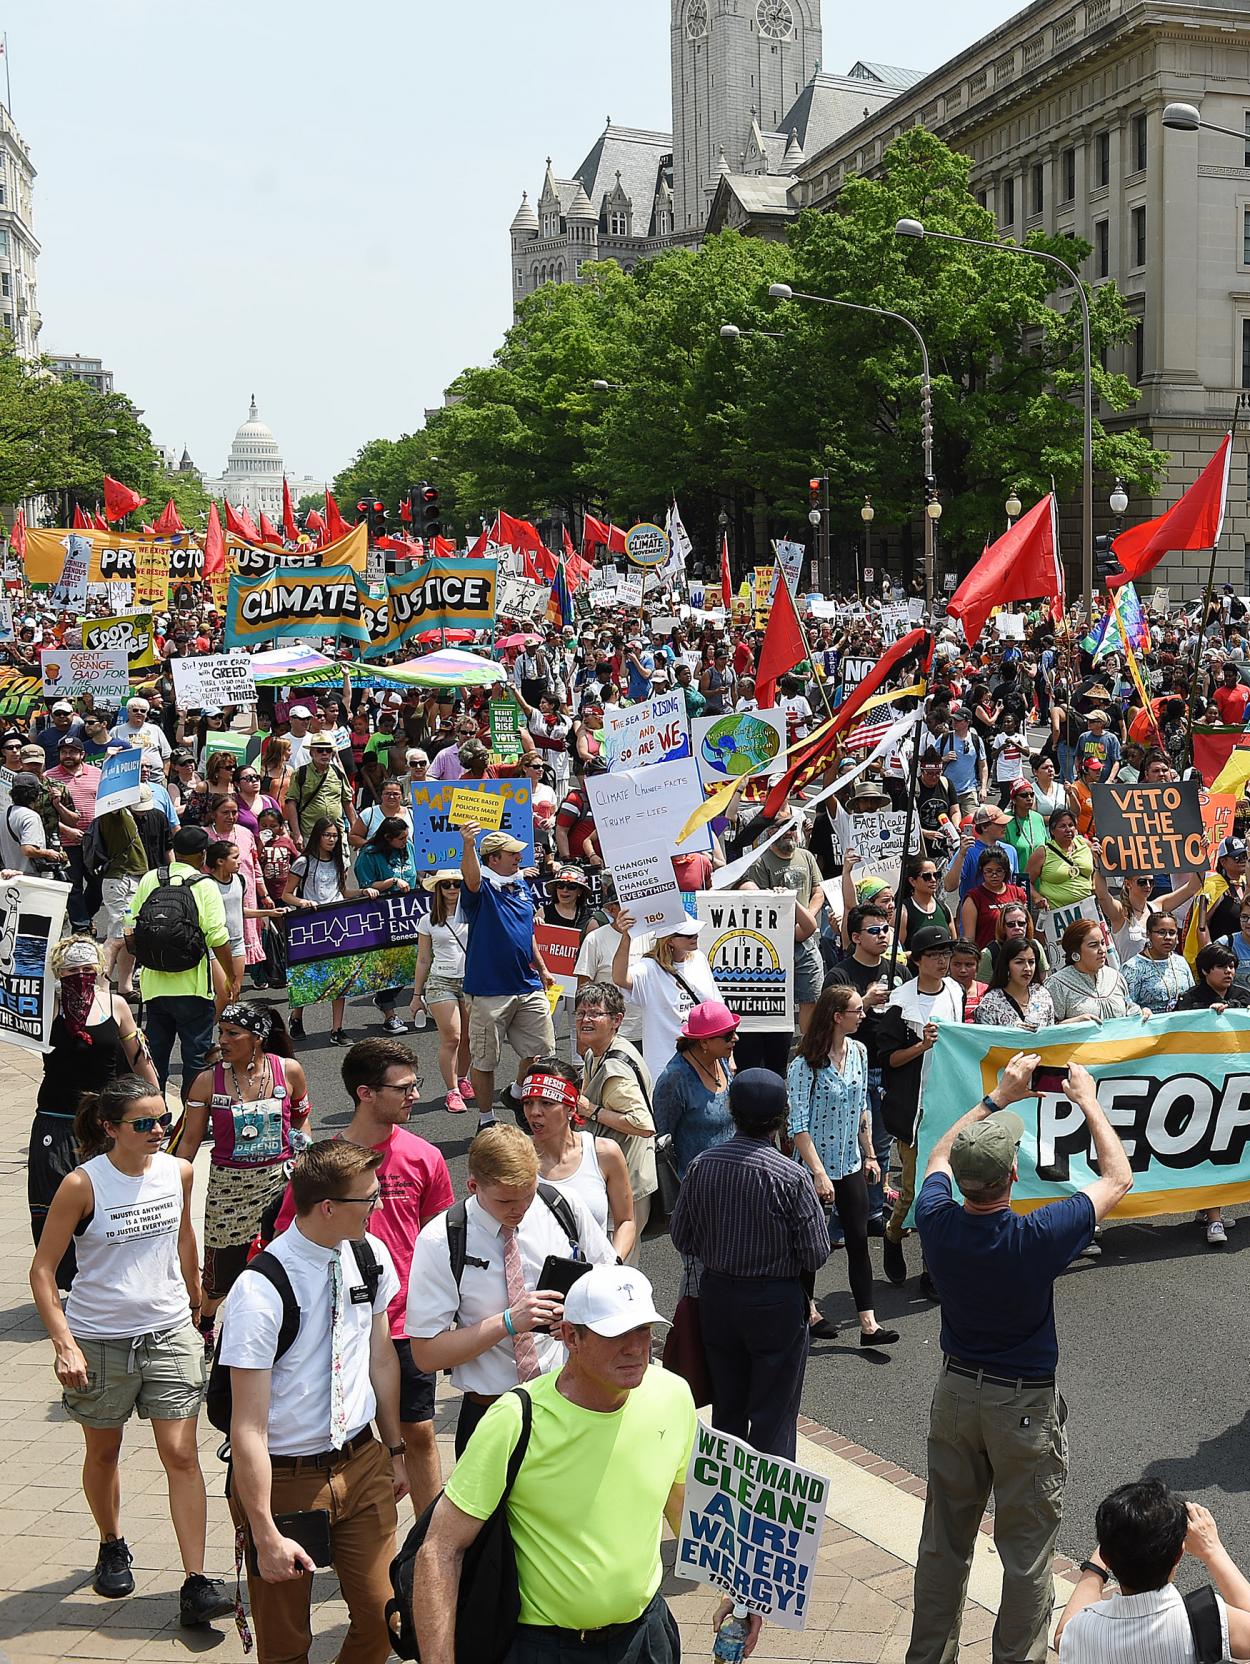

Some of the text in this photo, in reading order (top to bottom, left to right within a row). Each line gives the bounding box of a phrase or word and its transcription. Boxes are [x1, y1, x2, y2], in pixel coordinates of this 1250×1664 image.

[629, 540, 664, 551] CLIMATE
[633, 548, 664, 556] MOVEMENT
[243, 585, 358, 619] CLIMATE
[88, 621, 134, 647] FOOD
[70, 652, 103, 662] AGENT
[70, 661, 115, 670] ORANGE
[212, 667, 247, 679] GREED
[72, 670, 126, 680] BAD FOR
[611, 697, 679, 731] THE SEA IS RISING
[495, 722, 514, 731] RISE
[639, 725, 656, 739] AND
[495, 734, 516, 742] VOTE
[621, 720, 681, 762] SO ARE WE
[664, 778, 689, 789] FACTS
[457, 794, 499, 806] SCIENCE BASED
[1110, 788, 1181, 811] VETO
[455, 804, 498, 815] POLICIES MADE
[602, 815, 631, 829] TRUMP
[647, 806, 668, 817] LIES
[452, 812, 498, 824] AMERICA GREAT
[852, 815, 877, 829] FACE
[1122, 812, 1175, 833] THE
[852, 829, 878, 845] TAKE
[1101, 833, 1206, 872] CHEETO
[614, 856, 659, 872] CHANGING
[616, 869, 649, 882] ENERGY
[619, 877, 659, 892] CHANGES
[621, 883, 675, 900] EVERYTHING
[711, 909, 778, 929] WATER
[739, 937, 746, 946] IS
[722, 947, 763, 967] LIFE
[11, 979, 40, 995] THE
[15, 1017, 41, 1036] LAND
[543, 1076, 567, 1091] RESIST
[542, 1088, 565, 1102] RENEW
[236, 1142, 279, 1151] DEFEND
[110, 1202, 173, 1221] INJUSTICE ANYWHERE
[140, 1213, 162, 1223] THREAT
[116, 1226, 140, 1236] JUSTICE
[142, 1217, 178, 1231] EVERYWHERE
[699, 1429, 825, 1504] WE DEMAND
[693, 1457, 817, 1535] CLEAN:
[703, 1492, 800, 1558] AIR!
[689, 1511, 808, 1591] WATER!
[681, 1539, 807, 1616] ENERGY!
[708, 1573, 773, 1615] 1199SEIU
